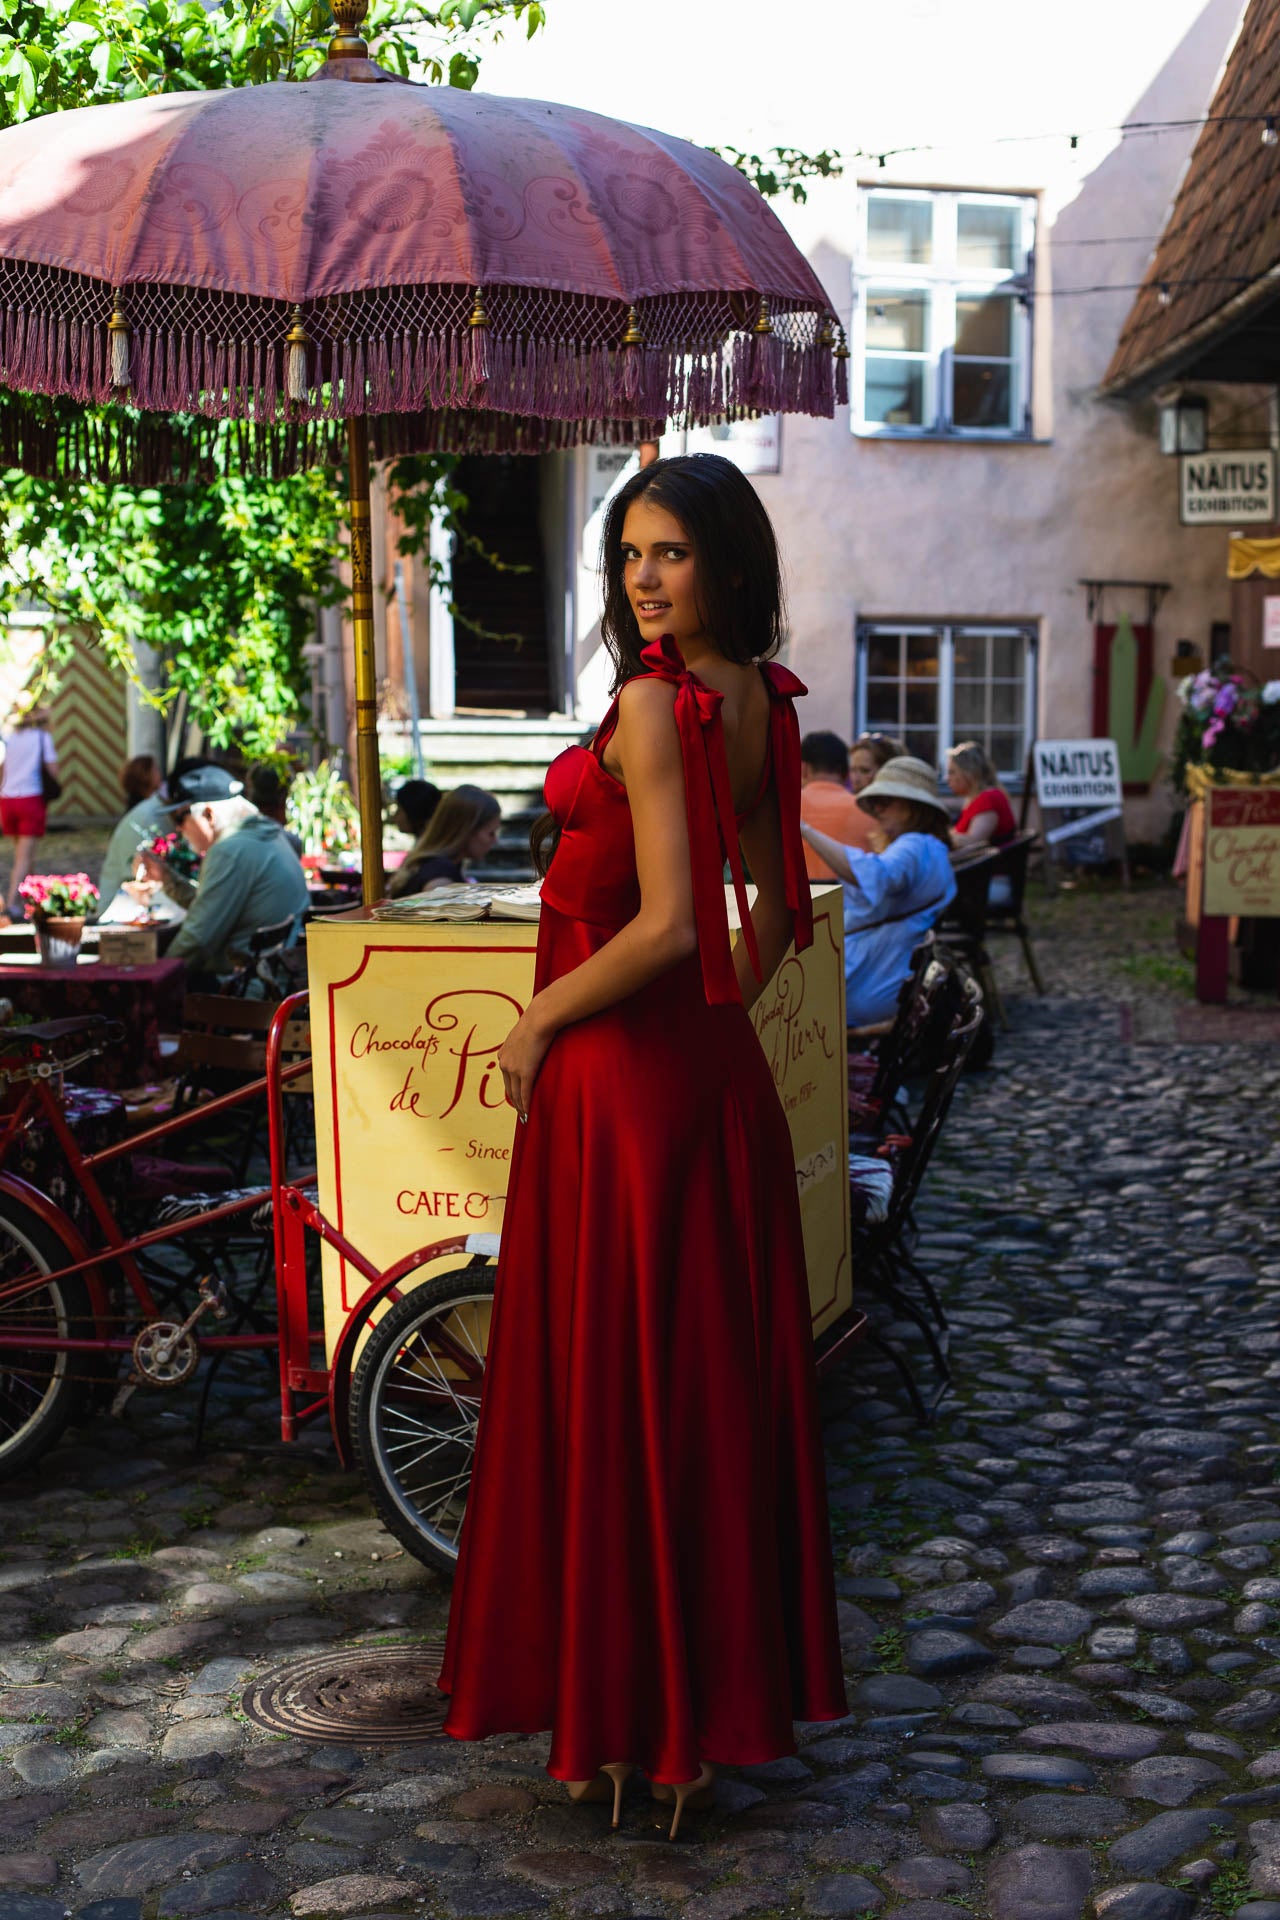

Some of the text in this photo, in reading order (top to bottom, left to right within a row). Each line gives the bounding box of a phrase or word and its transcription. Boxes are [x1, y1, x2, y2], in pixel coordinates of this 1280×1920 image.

[1188, 496, 1268, 514] EXHIBITION
[1044, 782, 1116, 798] EXHIBITION
[350, 990, 524, 1119] Chocolats Pi
[389, 1066, 432, 1118] de
[465, 1139, 511, 1161] Since
[396, 1190, 460, 1217] CAFE
